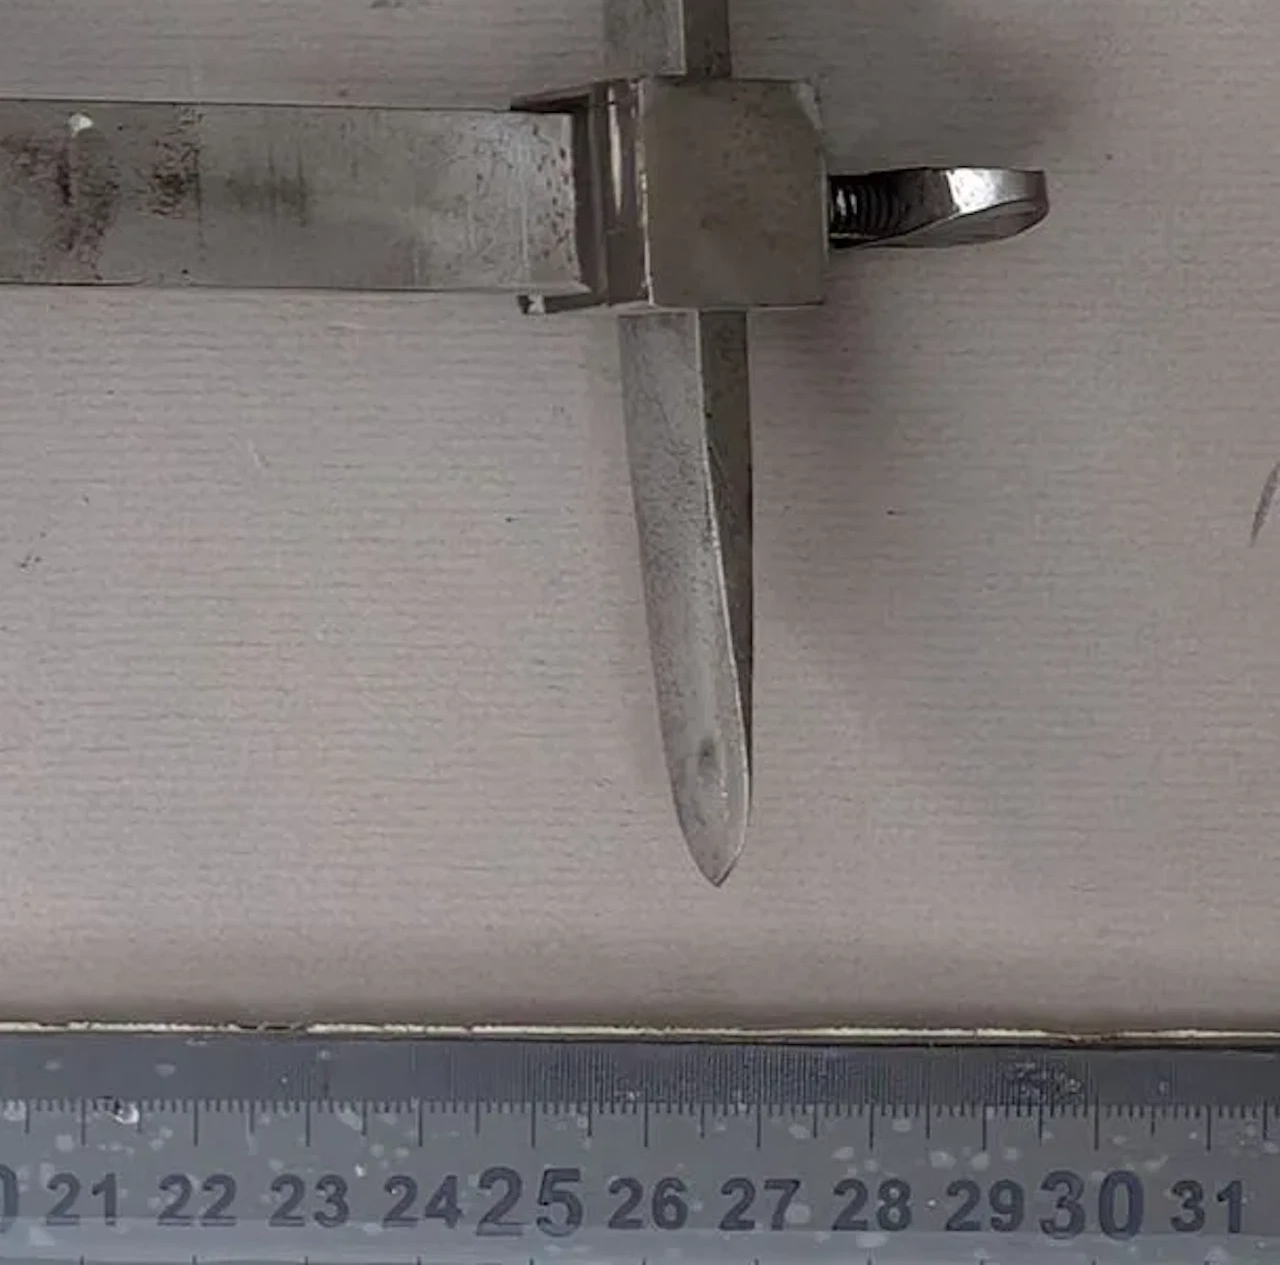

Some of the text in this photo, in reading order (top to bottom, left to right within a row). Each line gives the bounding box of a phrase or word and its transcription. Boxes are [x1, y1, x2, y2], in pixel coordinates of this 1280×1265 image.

[45, 1173, 118, 1226] 21
[157, 1173, 237, 1227] 22
[268, 1174, 350, 1228] 23
[382, 1175, 463, 1228] 24
[476, 1167, 584, 1236] 25
[607, 1177, 688, 1230] 26
[718, 1178, 801, 1231] 27
[832, 1178, 912, 1232] 28
[945, 1179, 1025, 1233] 29
[1040, 1169, 1144, 1240] 30
[1170, 1180, 1243, 1234] 31
